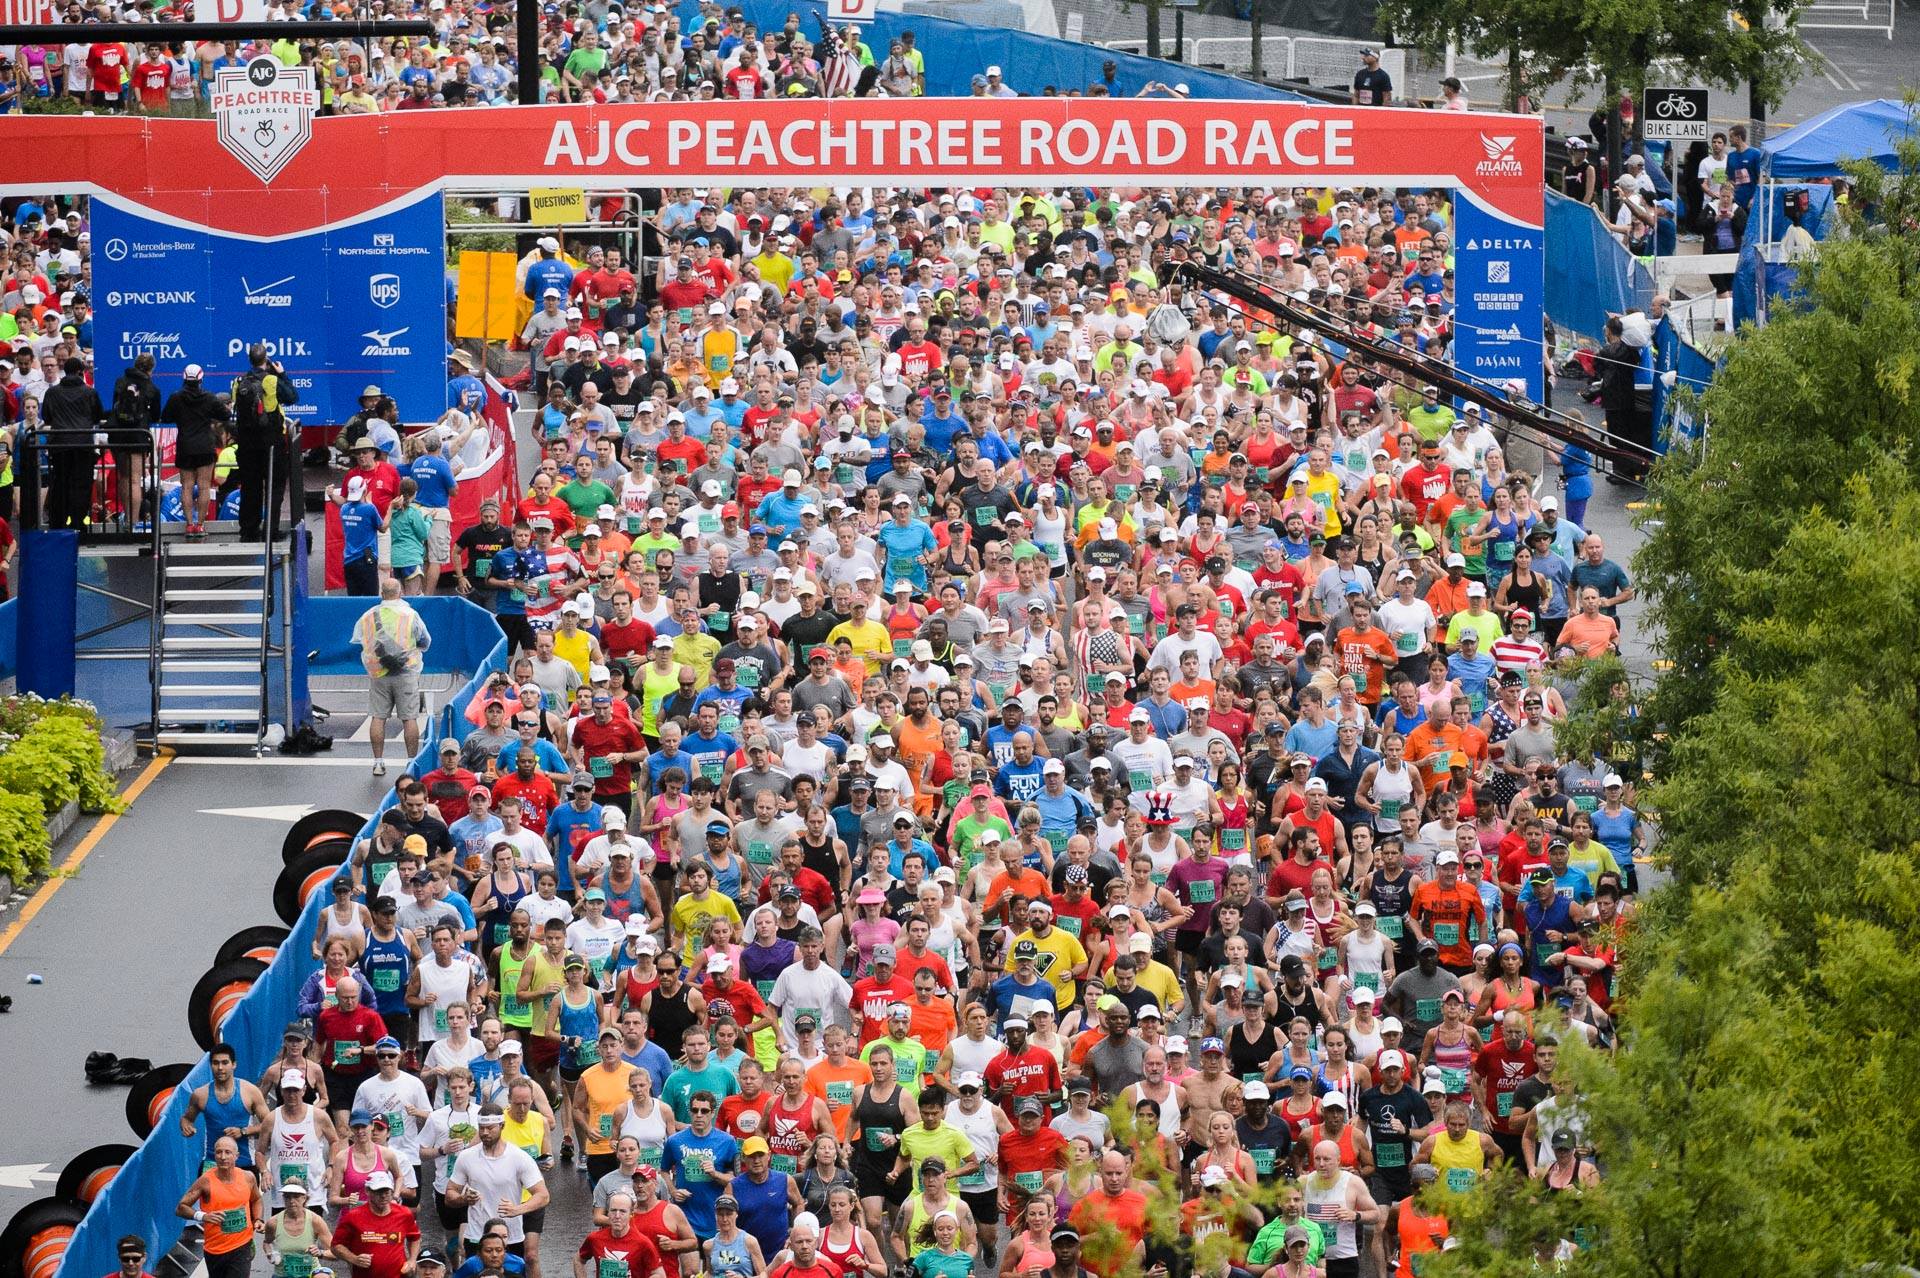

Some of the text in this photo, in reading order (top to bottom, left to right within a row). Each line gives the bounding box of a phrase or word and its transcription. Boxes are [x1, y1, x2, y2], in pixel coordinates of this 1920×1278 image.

[251, 67, 273, 80] AJC
[213, 91, 313, 109] PEACHTREE
[266, 107, 289, 115] RACE
[1647, 123, 1705, 136] BIKE LANE
[544, 119, 1354, 167] AJC PEACHTREE ROAD RACE
[1476, 160, 1523, 171] ATLANTA
[533, 194, 581, 209] QUESTIONS?
[132, 241, 195, 252] Mercedes-Benz
[1482, 239, 1533, 250] DELTA
[389, 247, 430, 255] HOSPITAL
[124, 290, 196, 305] PNC BANK
[372, 284, 399, 304] ups
[244, 294, 292, 307] verizon
[1475, 356, 1521, 368] DASANI
[1009, 779, 1040, 790] RUN
[1003, 1064, 1044, 1080] WOLFPACK
[1021, 1076, 1027, 1084] S
[278, 1150, 309, 1158] ATLANTA
